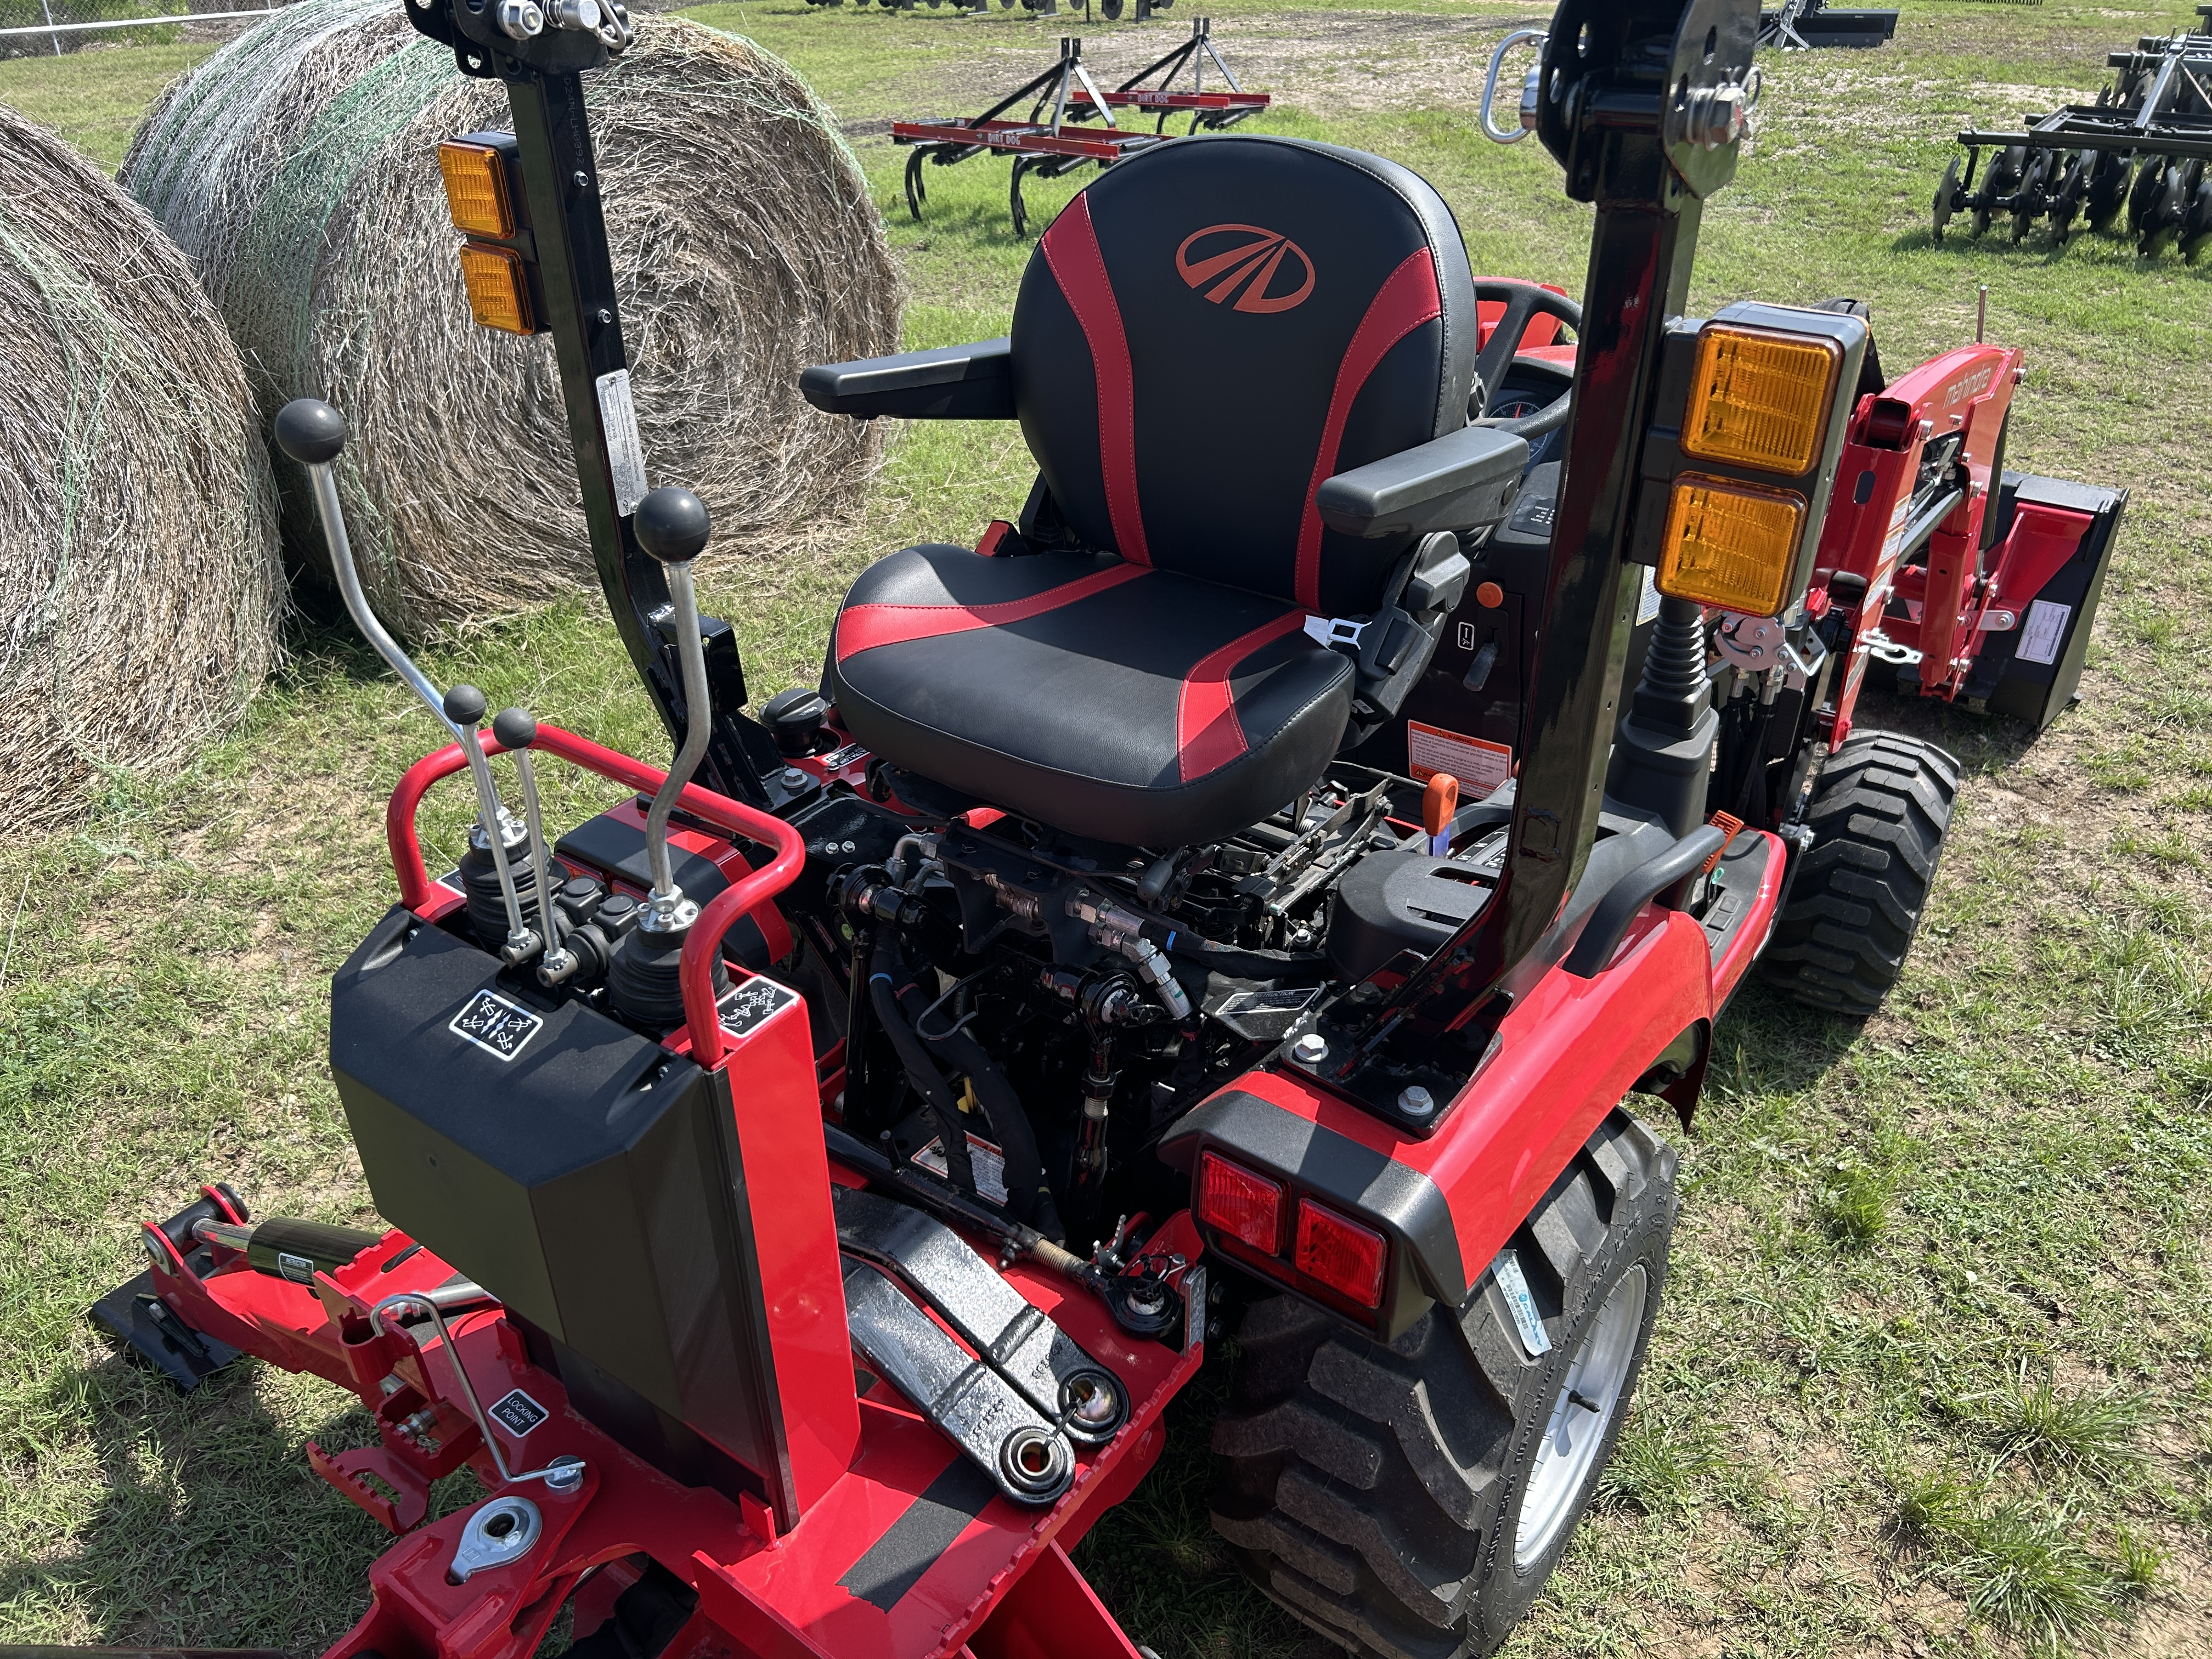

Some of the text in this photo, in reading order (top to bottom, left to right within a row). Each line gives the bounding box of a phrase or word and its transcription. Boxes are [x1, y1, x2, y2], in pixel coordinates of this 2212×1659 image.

[988, 132, 1021, 145] DIRT DOG
[1943, 363, 1991, 410] mahindra
[1522, 1302, 1542, 1347] GALAXY
[501, 1407, 525, 1426] POINT
[507, 1396, 538, 1423] LOCKING
